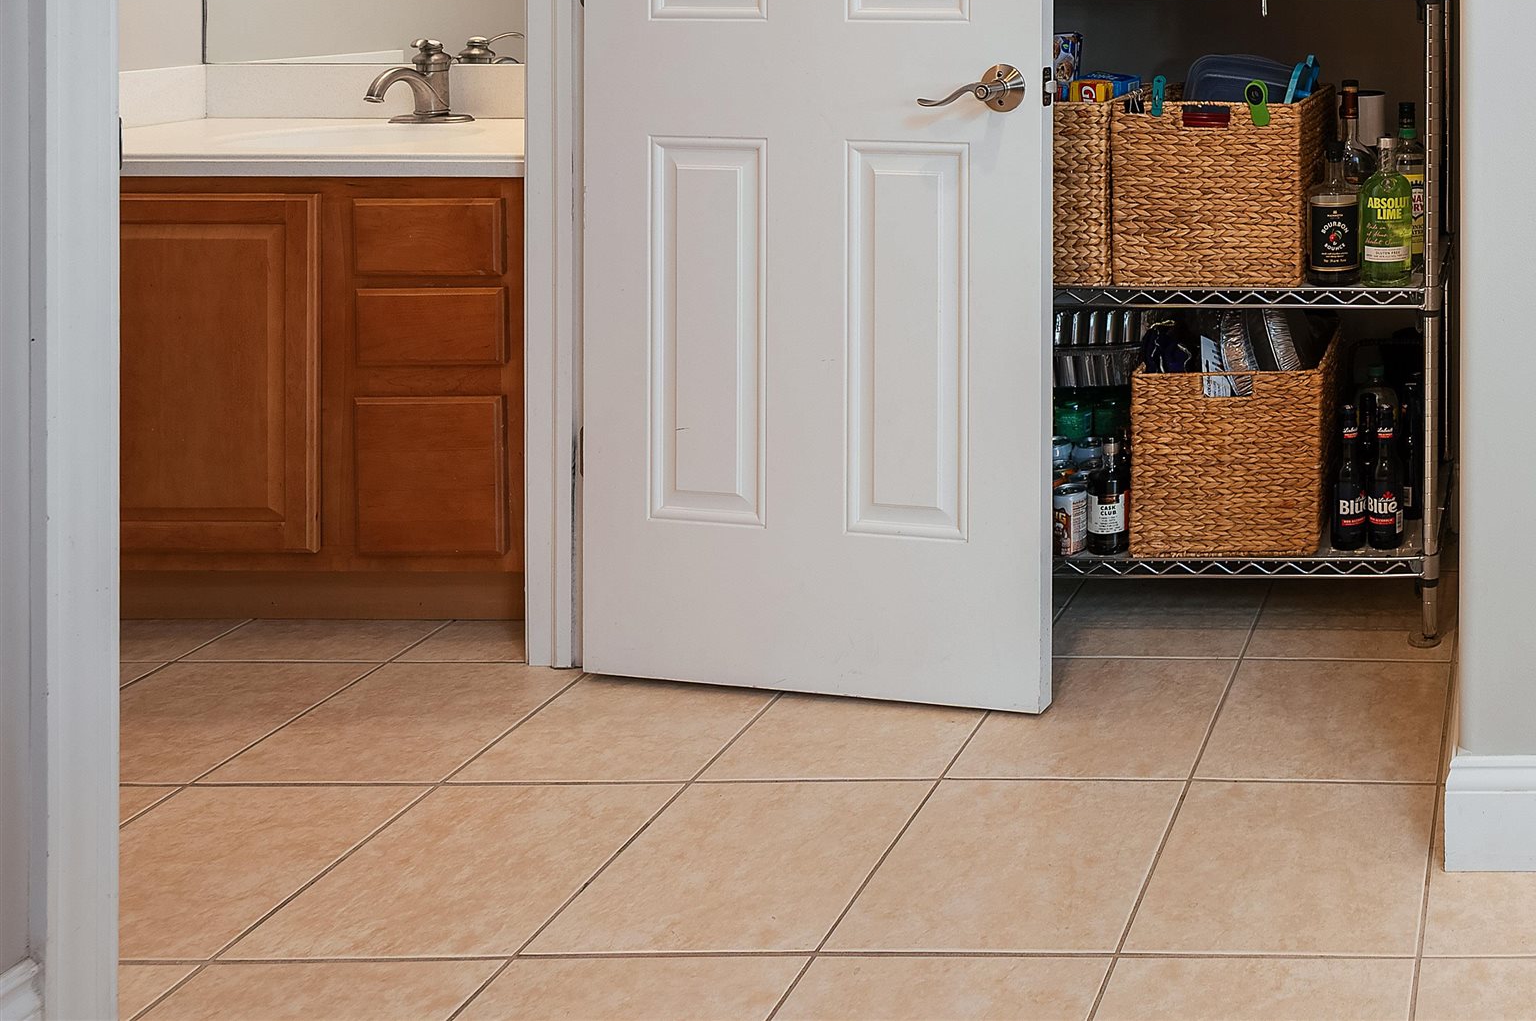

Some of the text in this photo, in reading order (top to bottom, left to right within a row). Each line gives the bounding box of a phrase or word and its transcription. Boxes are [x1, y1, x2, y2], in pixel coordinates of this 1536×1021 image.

[1367, 197, 1410, 209] ABSOLUT
[1377, 208, 1402, 220] LIME
[1320, 221, 1350, 235] BOURBON
[1367, 496, 1398, 514] Blue
